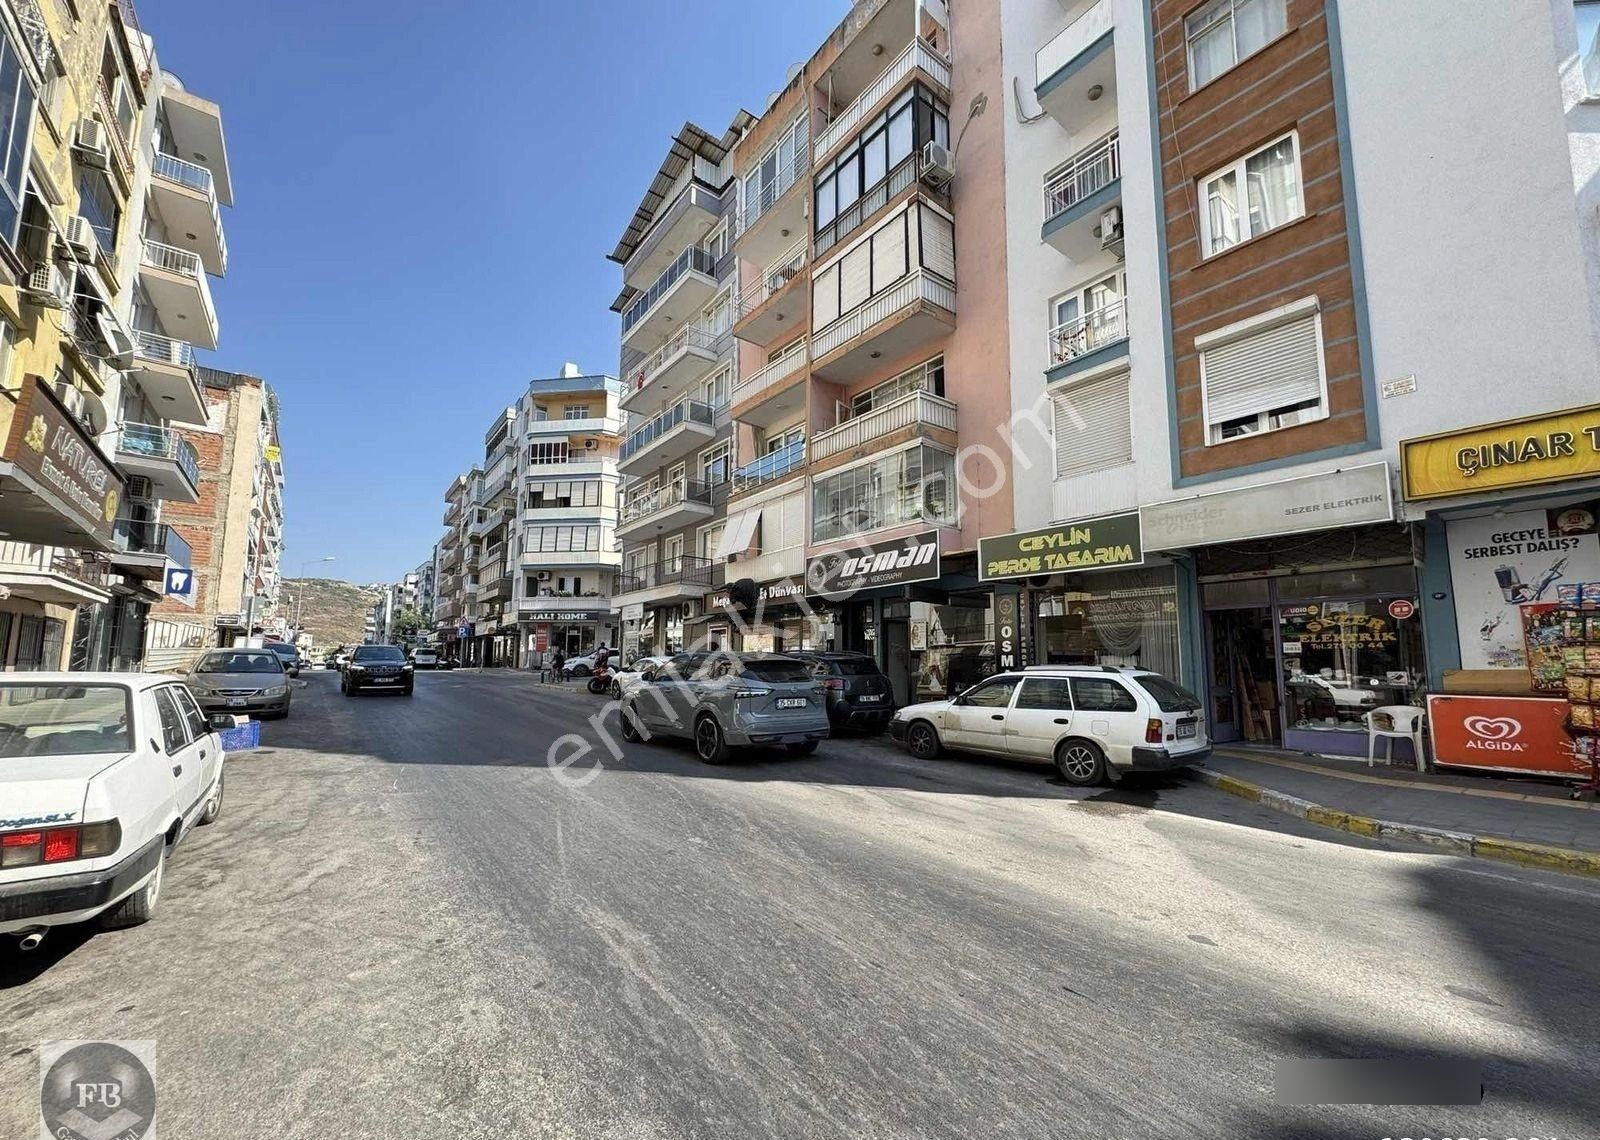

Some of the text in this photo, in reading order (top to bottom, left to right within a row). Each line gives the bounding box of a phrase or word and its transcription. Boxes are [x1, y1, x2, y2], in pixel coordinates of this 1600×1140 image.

[51, 425, 107, 497] NATUREL
[1456, 431, 1575, 476] ÇINAR
[1285, 494, 1383, 516] SEZER ELEKTRİK
[1019, 527, 1091, 552] CEYLİN
[1464, 537, 1580, 559] SERBEST DALIŞ?
[1491, 528, 1546, 544] GECEYE
[987, 544, 1134, 576] PERDE TASARIM
[1001, 626, 1014, 673] OSM
